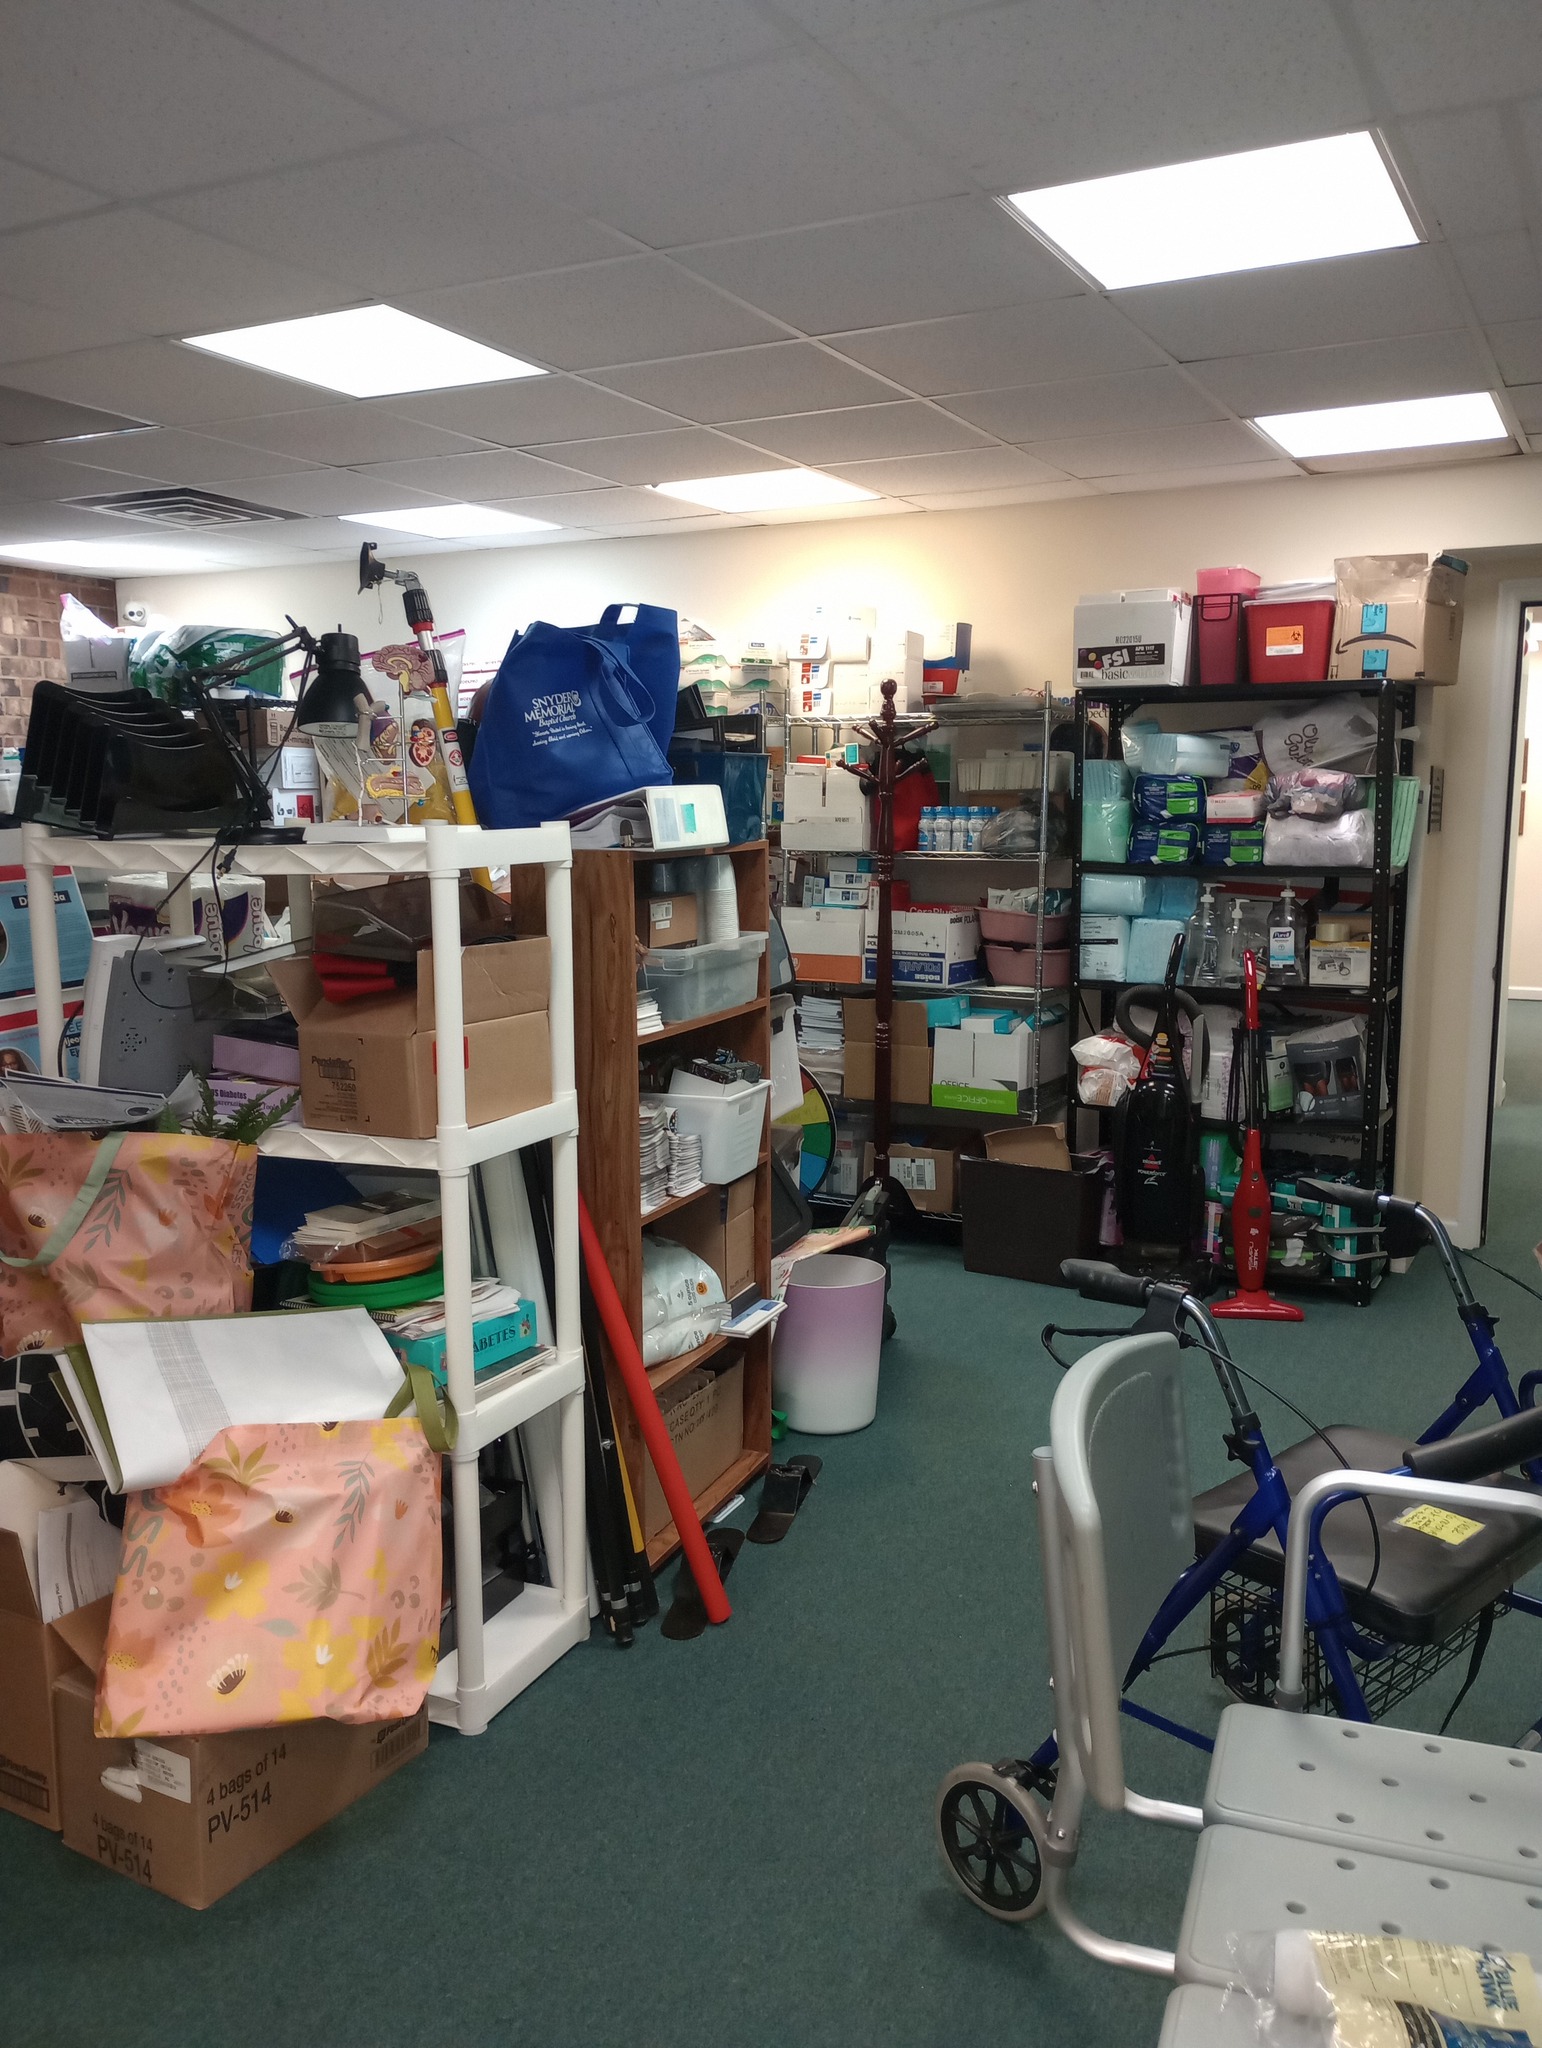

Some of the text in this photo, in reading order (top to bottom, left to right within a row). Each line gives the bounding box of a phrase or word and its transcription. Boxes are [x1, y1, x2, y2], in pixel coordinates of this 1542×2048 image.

[1102, 648, 1130, 670] FSI
[524, 703, 575, 723] MEMORIAL
[531, 691, 573, 709] SNYDER
[219, 1089, 248, 1099] Diabetes
[473, 1325, 516, 1353] ABETES
[206, 1743, 287, 1806] 4 bags of 14
[207, 1782, 273, 1843] PV-514
[92, 1812, 153, 1854] 4 bags of 14
[97, 1833, 153, 1883] PV-514
[1493, 1970, 1520, 2013] BLUE
